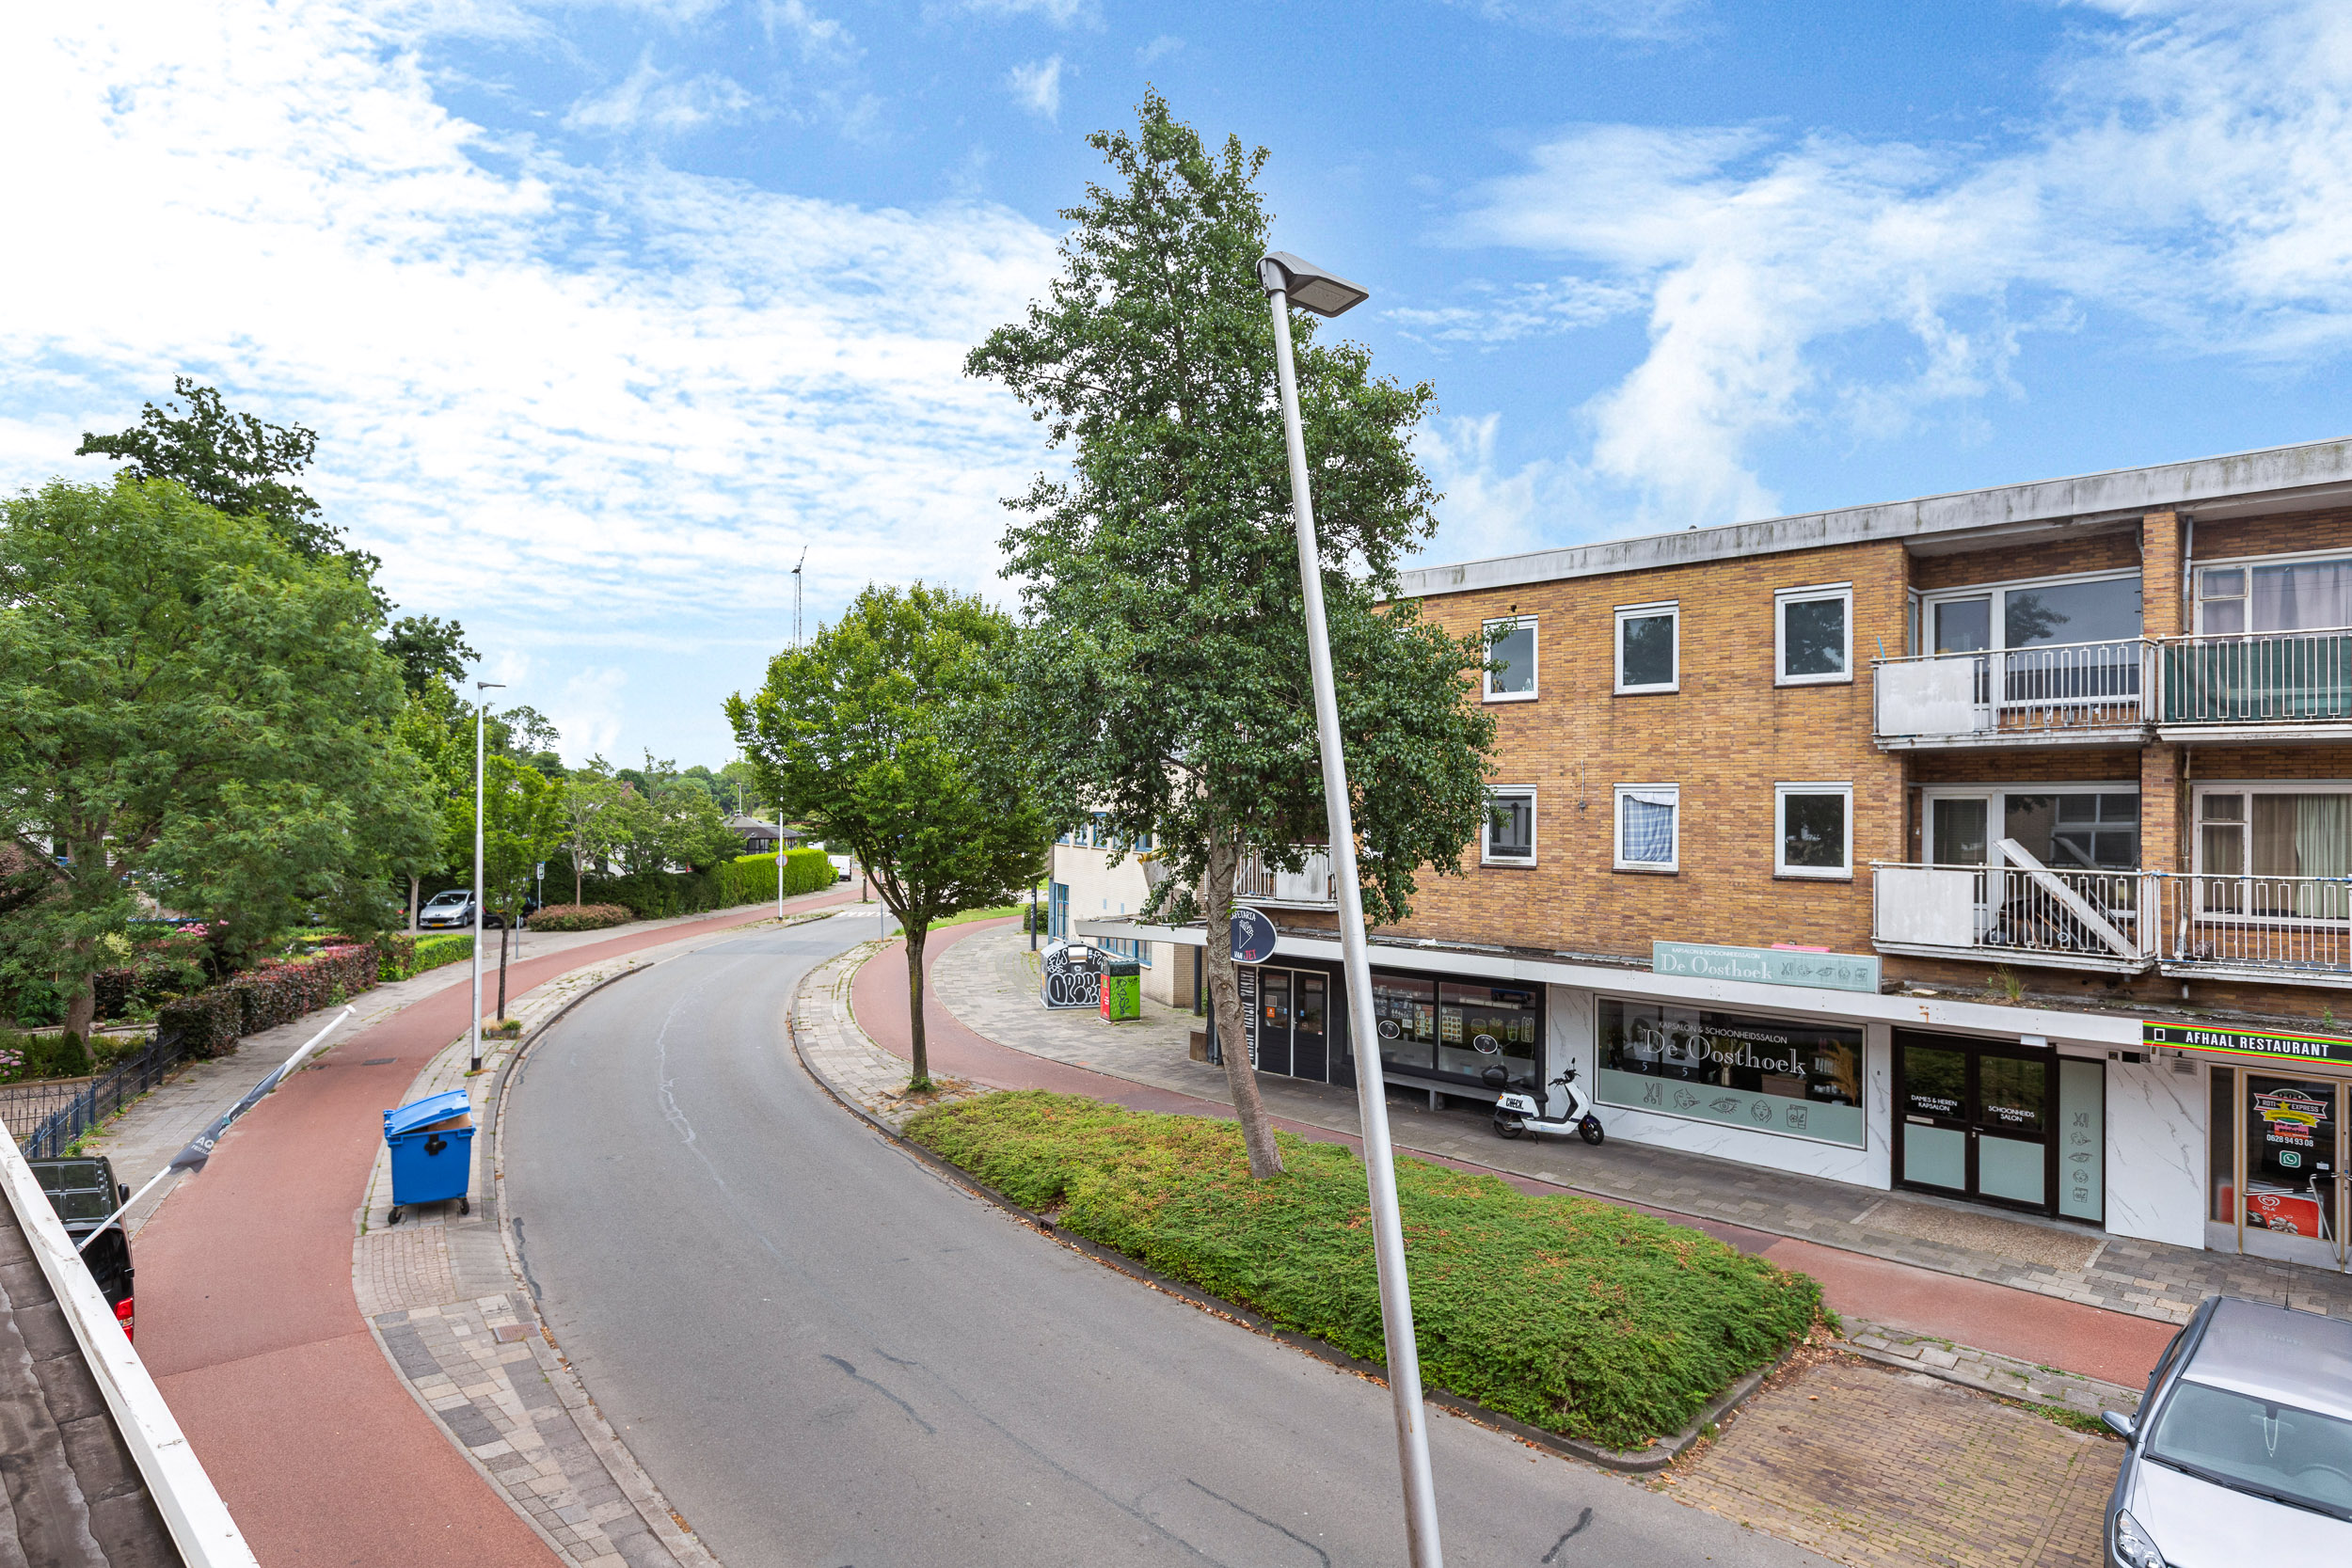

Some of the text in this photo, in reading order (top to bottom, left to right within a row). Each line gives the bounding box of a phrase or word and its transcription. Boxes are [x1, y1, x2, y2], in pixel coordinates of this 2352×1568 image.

[1233, 948, 1257, 960] VAN JET
[1661, 954, 1772, 979] De Oosthoek
[1659, 1022, 1696, 1033] KAPSALON
[1705, 1026, 1788, 1044] SCHOONHEIDSSALON
[2185, 1031, 2329, 1057] AFHAAL RESTAURANT
[1643, 1028, 1806, 1075] De Oosthoek
[1642, 1061, 1648, 1071] 5
[1681, 1067, 1689, 1077] 5
[1911, 1094, 1931, 1103] DAMES
[1937, 1099, 1958, 1107] HEREN
[1918, 1101, 1950, 1112] KAPSALON
[1988, 1105, 2035, 1118] SCHOONHEIDS
[2000, 1113, 2023, 1122] SALON
